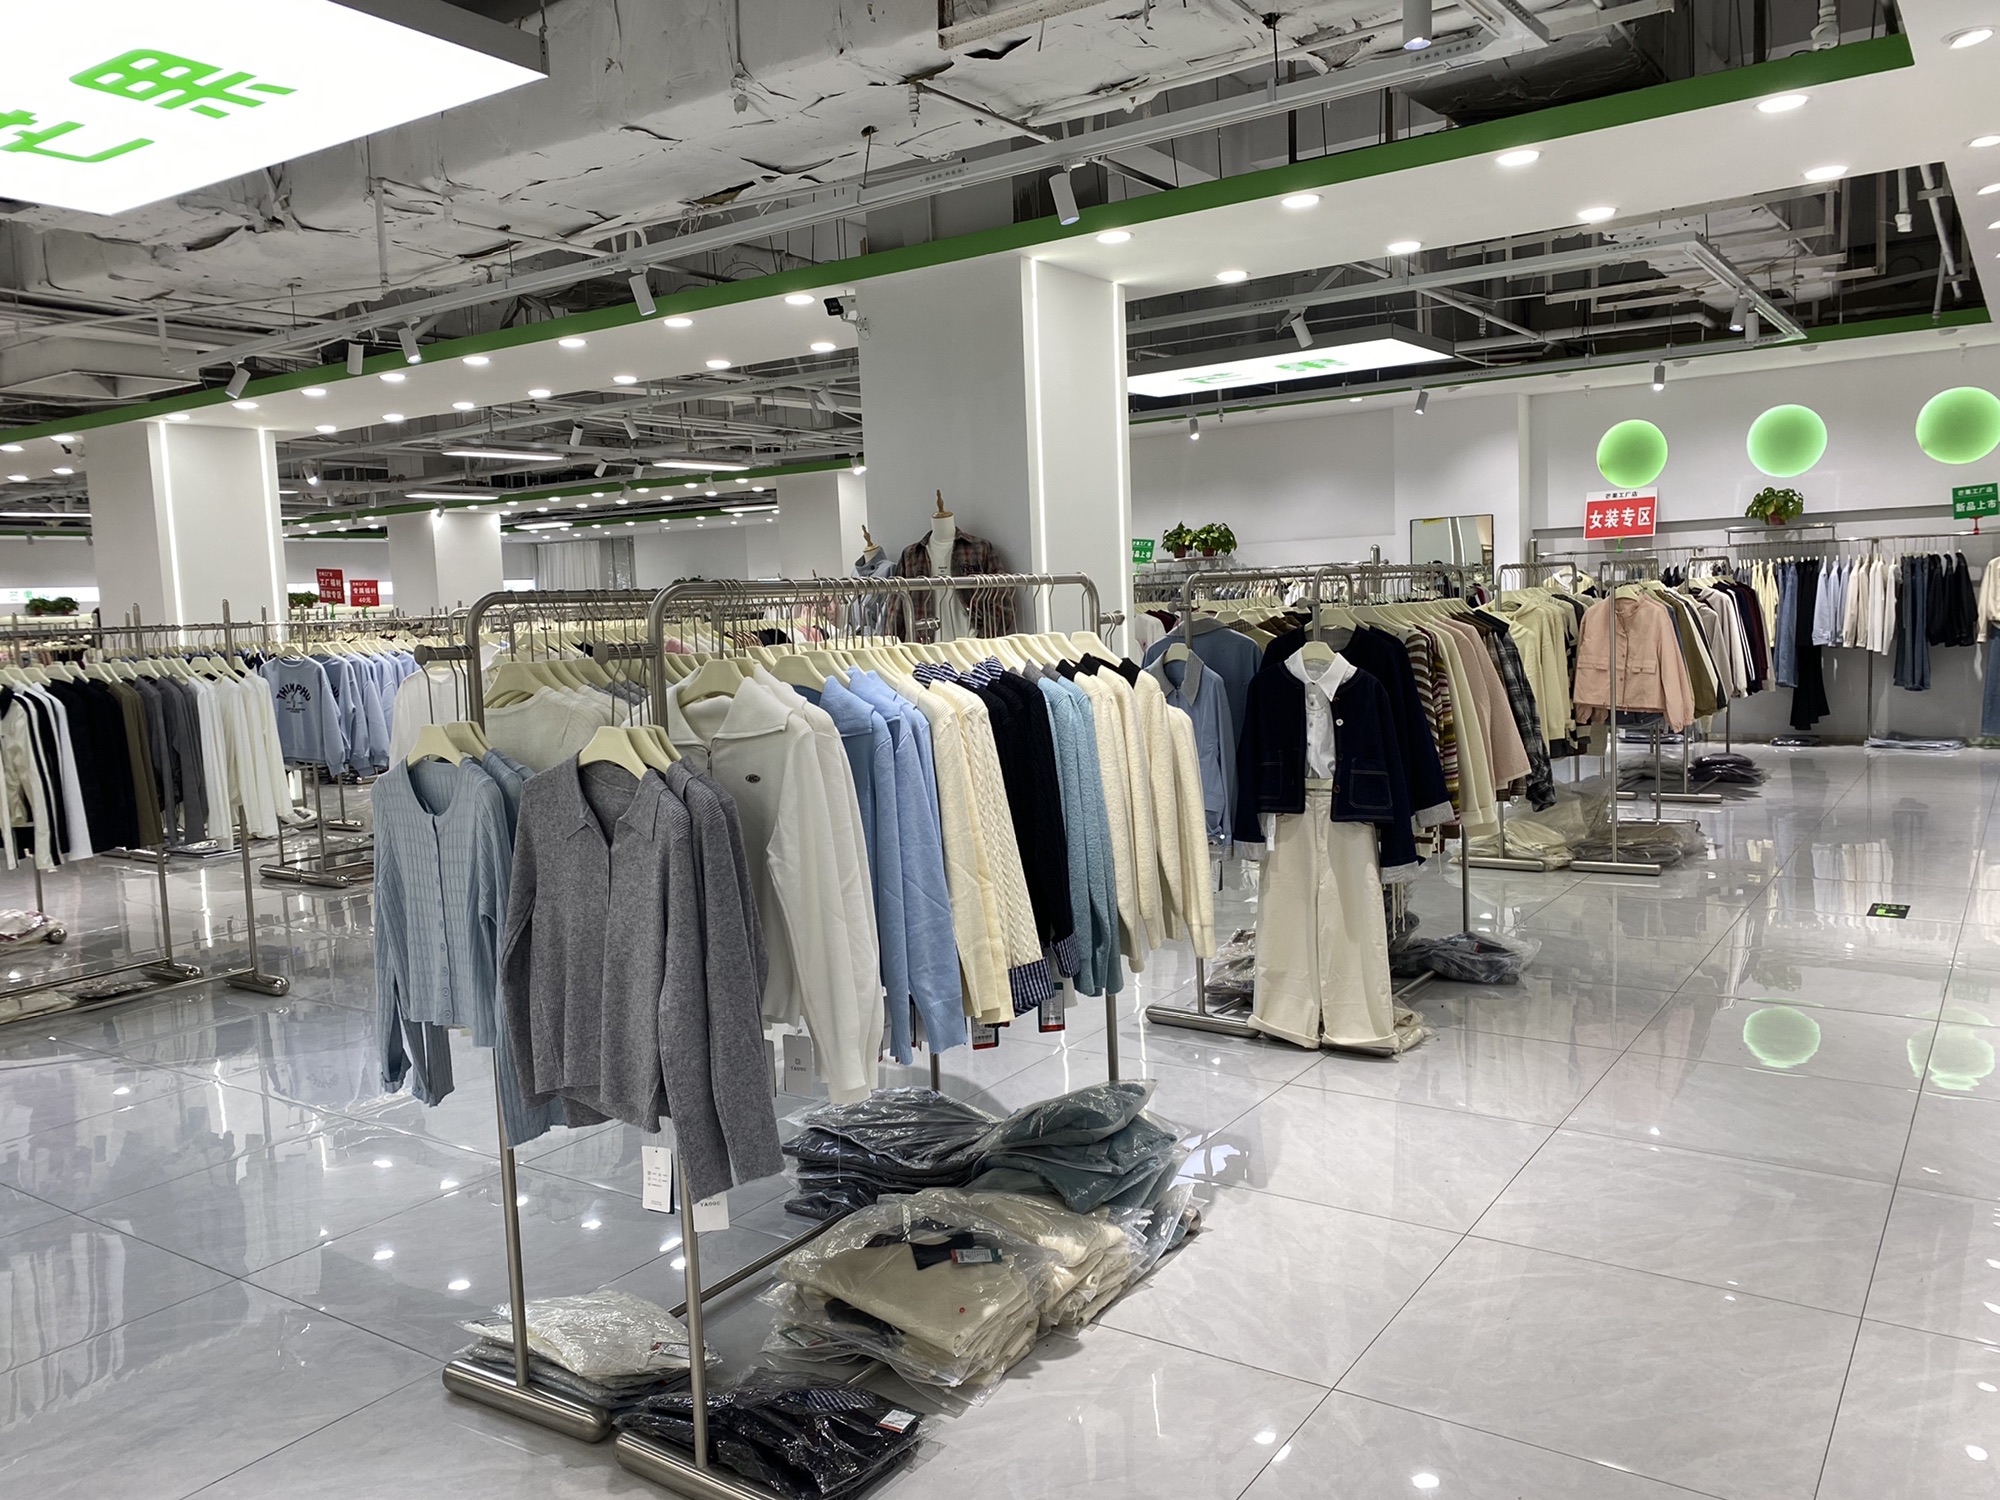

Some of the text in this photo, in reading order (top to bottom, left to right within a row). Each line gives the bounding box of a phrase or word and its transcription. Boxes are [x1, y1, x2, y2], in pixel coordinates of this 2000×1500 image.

[1605, 491, 1638, 499] 芒果工厂店
[1955, 499, 1997, 512] 新品上市
[1589, 506, 1652, 530] 女装专区
[1132, 550, 1152, 559] 品上市
